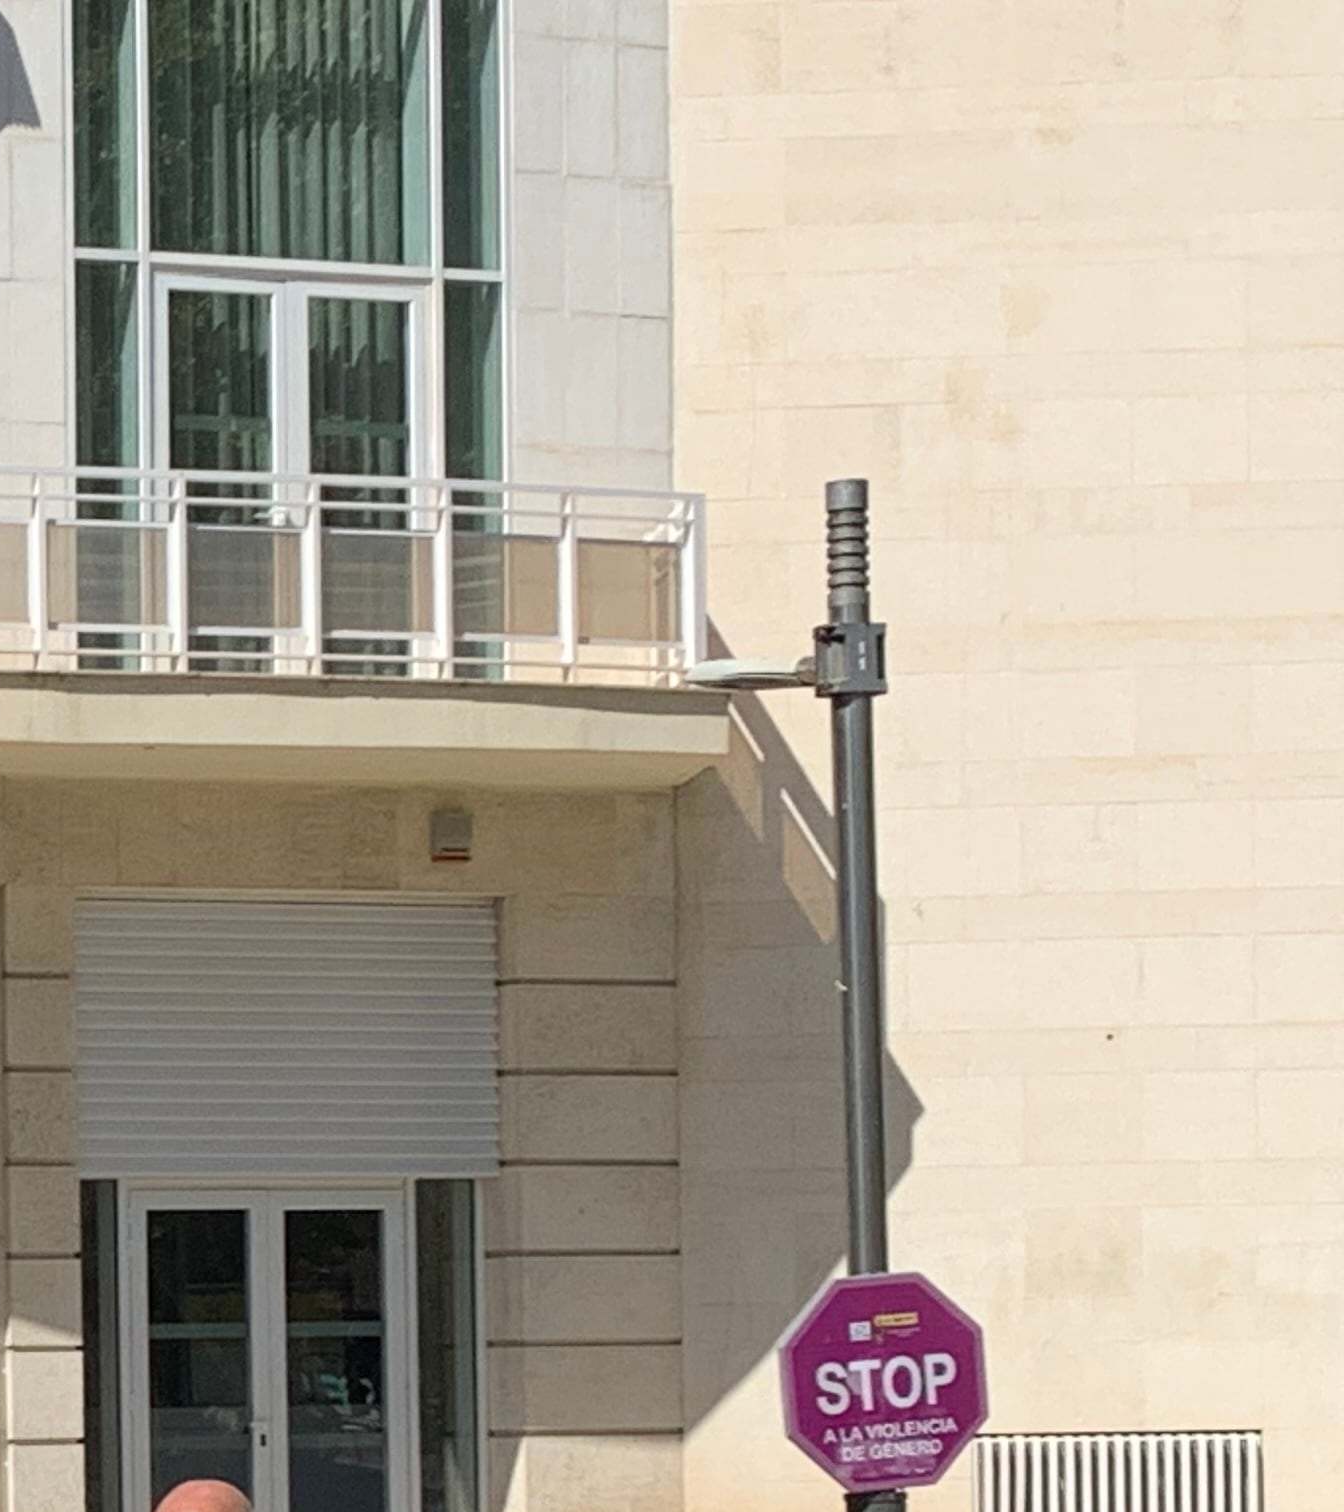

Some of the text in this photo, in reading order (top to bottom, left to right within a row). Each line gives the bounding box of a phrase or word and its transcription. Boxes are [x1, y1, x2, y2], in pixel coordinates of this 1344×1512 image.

[815, 1352, 958, 1416] STOP
[823, 1417, 958, 1444] A LA VIOLENCIA
[841, 1446, 866, 1463] DE
